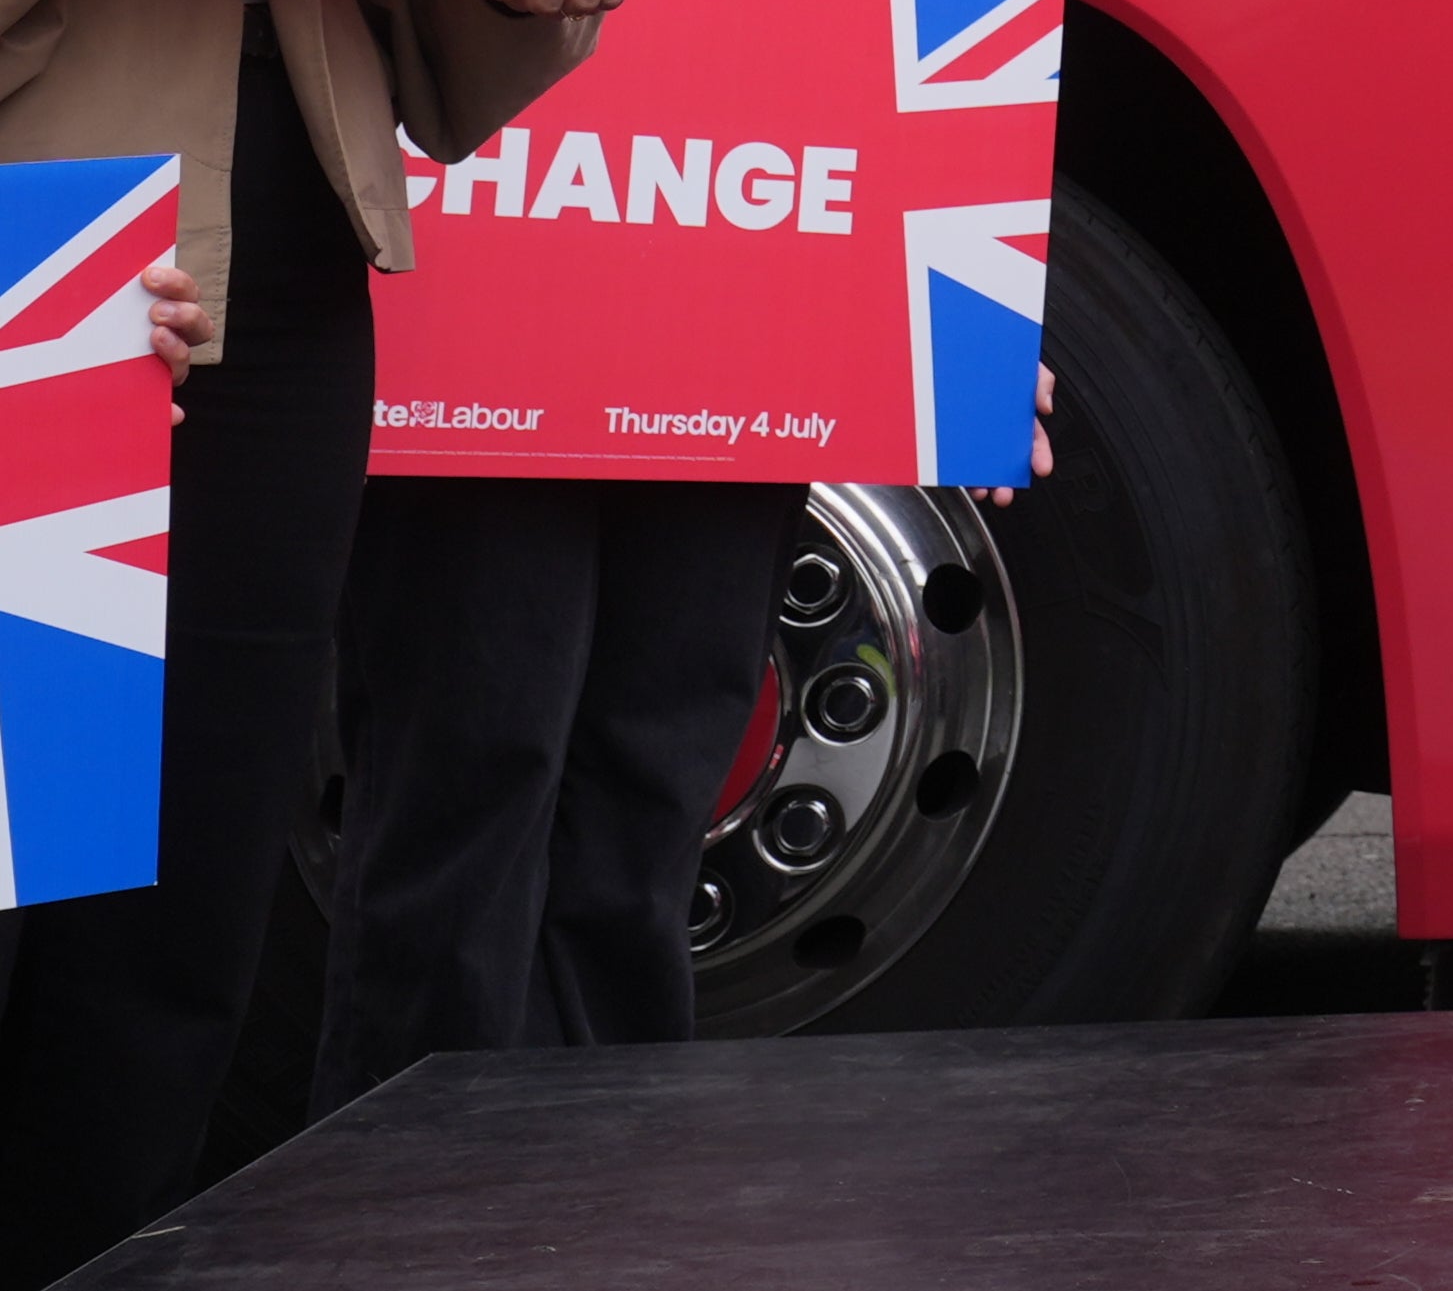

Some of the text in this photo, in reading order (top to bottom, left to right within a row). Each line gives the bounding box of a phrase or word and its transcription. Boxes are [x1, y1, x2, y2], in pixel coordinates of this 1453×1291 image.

[437, 402, 544, 430] Labour
[605, 407, 746, 444] Thursday
[751, 412, 769, 436] 4
[775, 413, 836, 447] July
